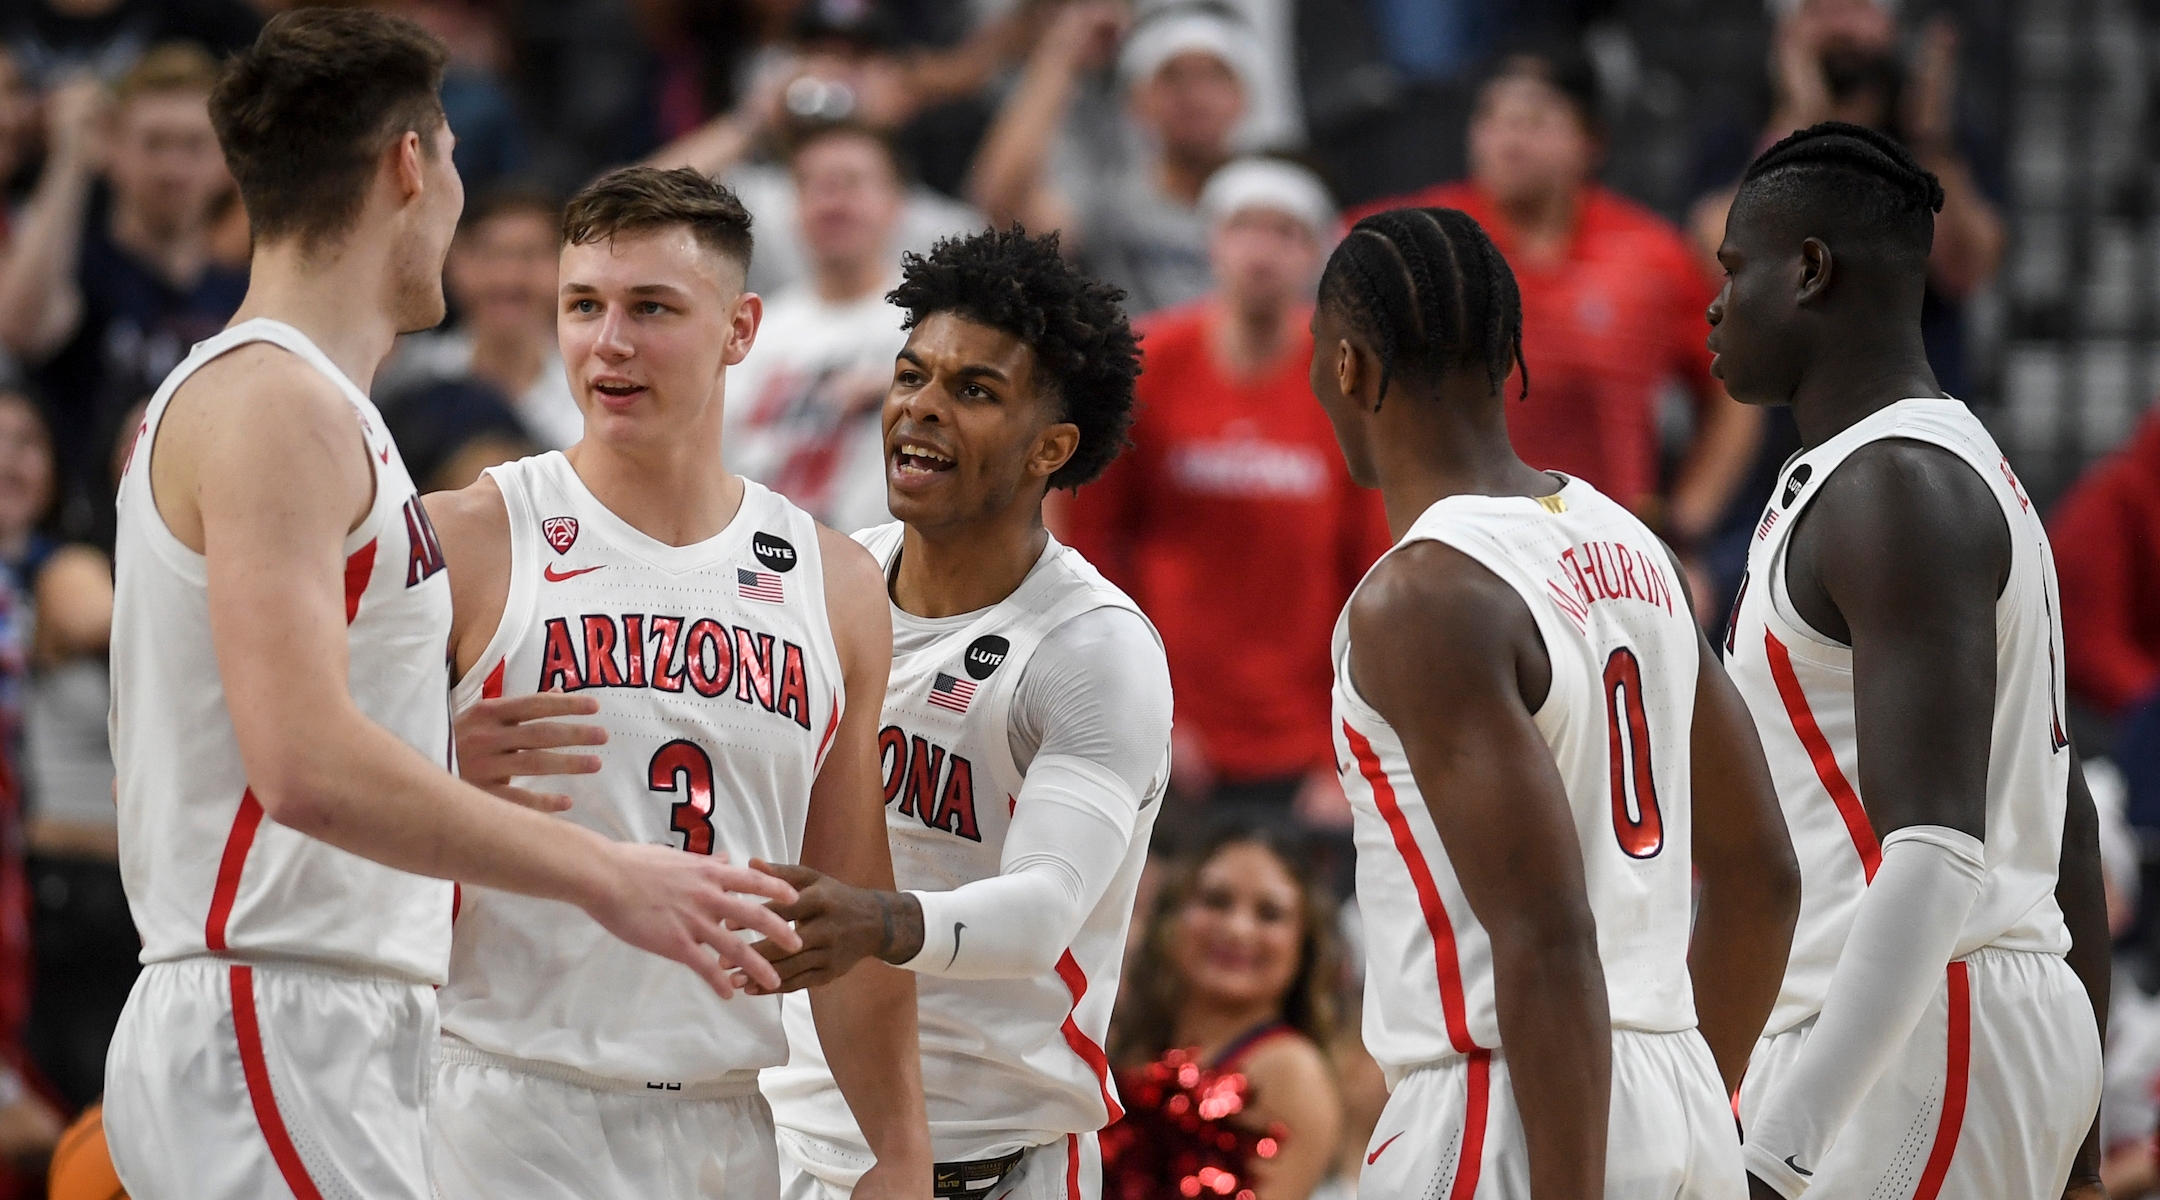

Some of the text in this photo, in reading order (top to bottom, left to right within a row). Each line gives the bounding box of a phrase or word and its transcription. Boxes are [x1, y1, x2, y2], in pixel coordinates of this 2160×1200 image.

[544, 518, 577, 539] PAC
[552, 531, 570, 546] 12
[755, 541, 794, 559] LUTE
[1546, 541, 1673, 637] MATHURIN
[537, 613, 812, 731] ARIZONA
[970, 647, 1004, 666] LUTE
[1602, 645, 1665, 860] 0
[647, 738, 716, 856] 3
